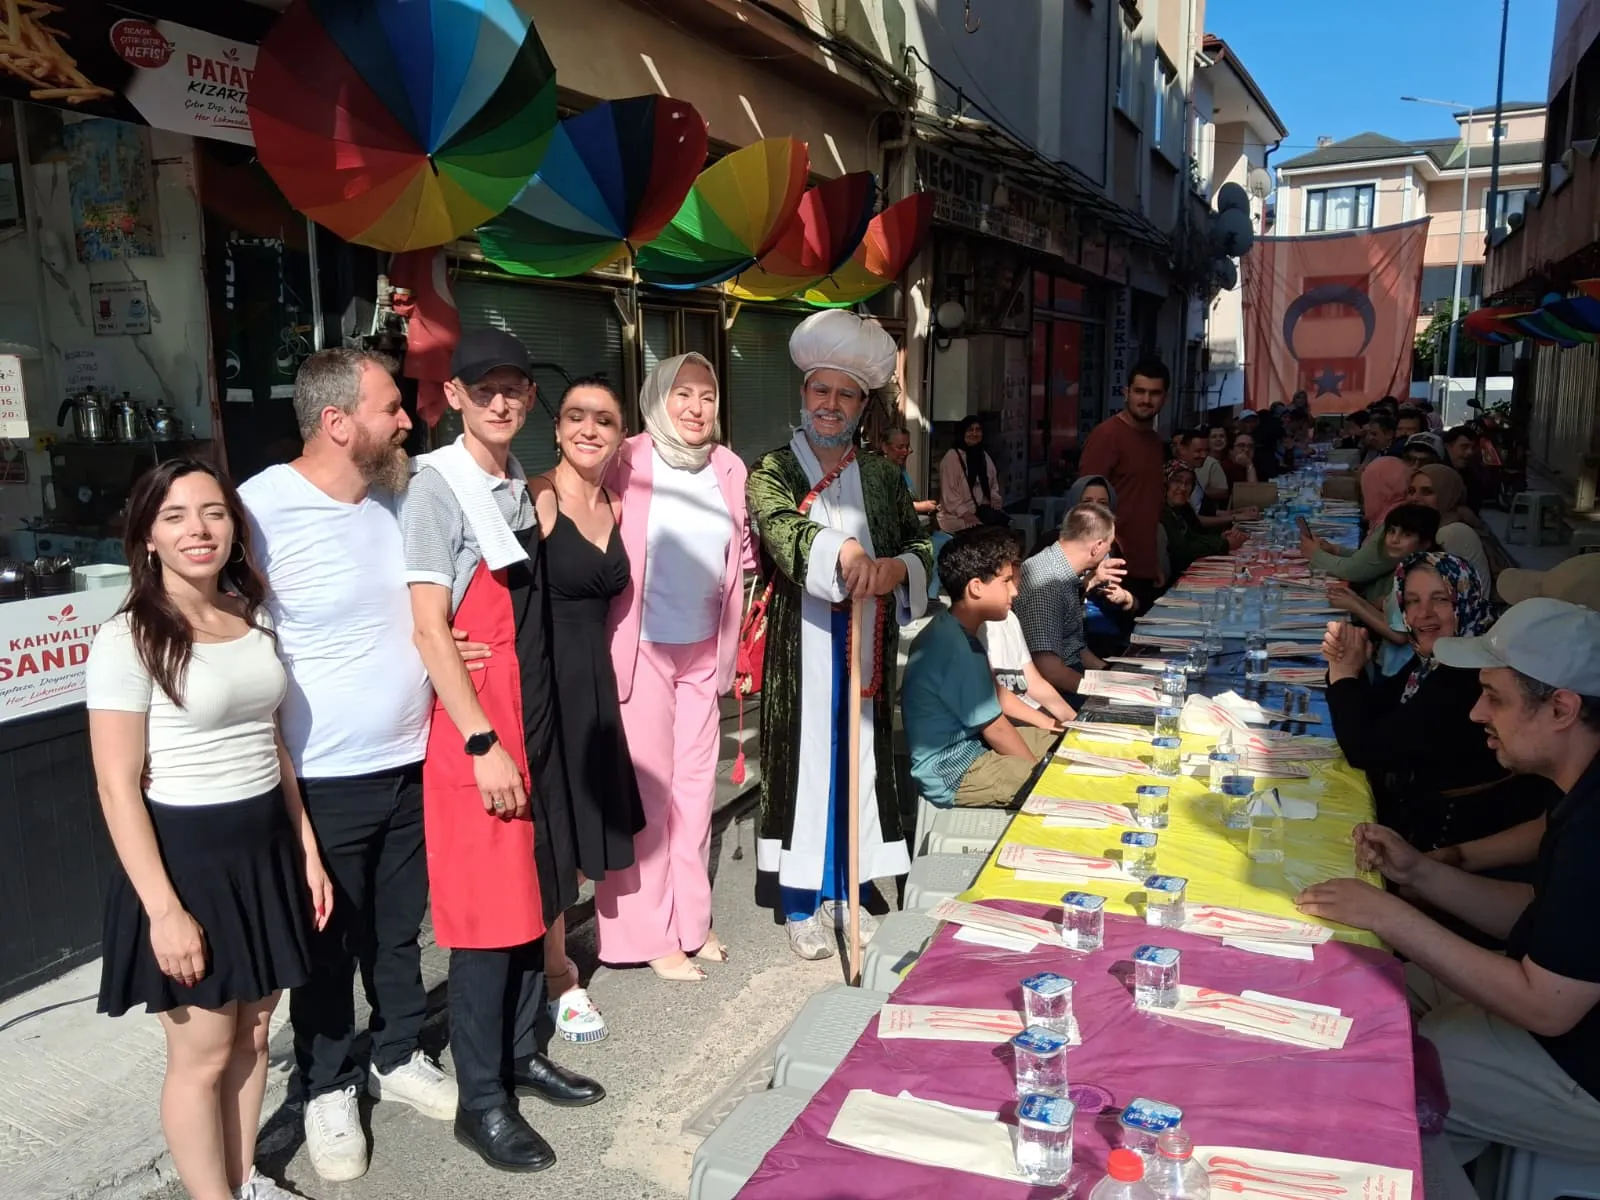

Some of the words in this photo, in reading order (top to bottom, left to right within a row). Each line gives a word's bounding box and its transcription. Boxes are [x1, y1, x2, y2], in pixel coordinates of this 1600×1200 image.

[187, 80, 248, 105] KIZART
[9, 623, 102, 652] KAHVALTI
[0, 642, 93, 682] SAND
